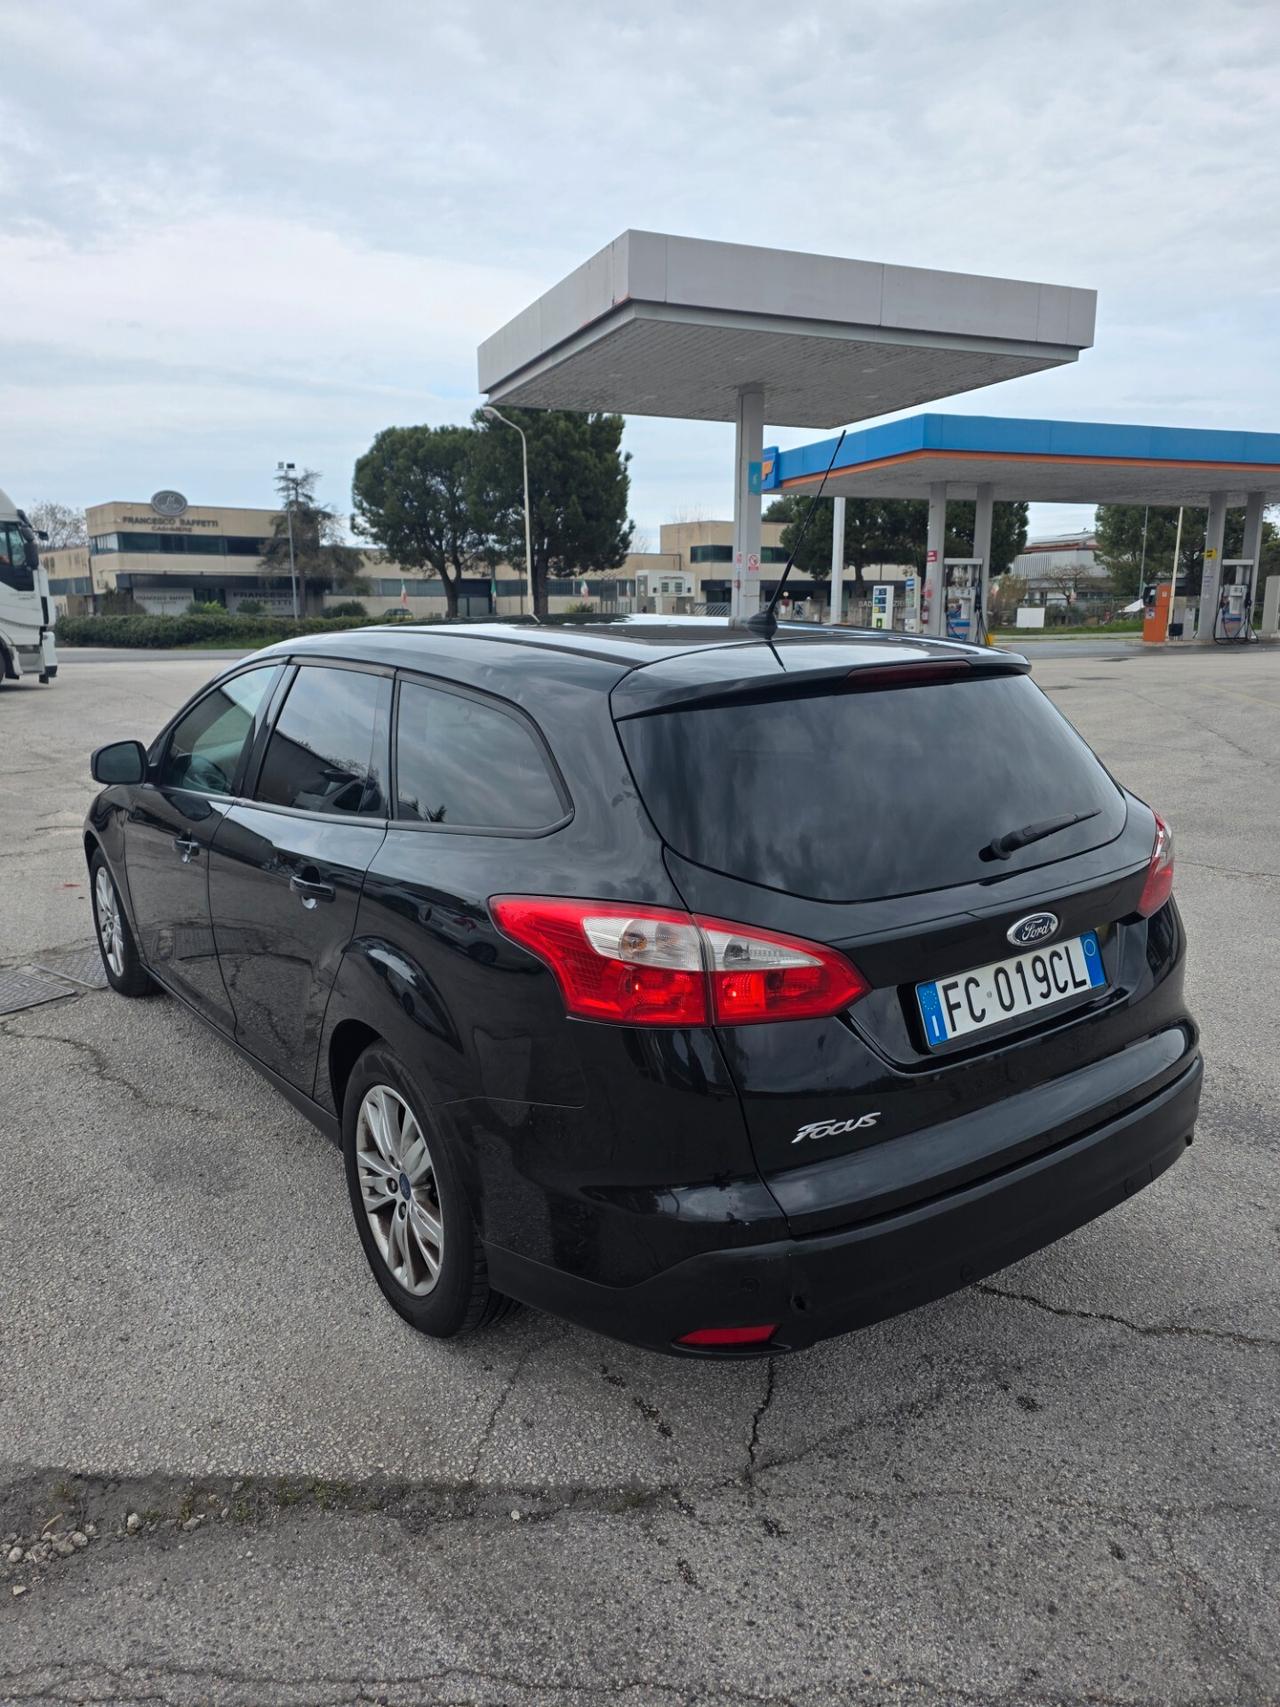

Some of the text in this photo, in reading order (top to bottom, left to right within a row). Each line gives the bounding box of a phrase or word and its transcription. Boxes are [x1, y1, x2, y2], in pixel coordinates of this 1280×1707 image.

[122, 516, 175, 526] FRANCESCO
[1021, 918, 1051, 939] Ford
[942, 976, 986, 1032] FC
[994, 946, 1087, 1011] 019CL
